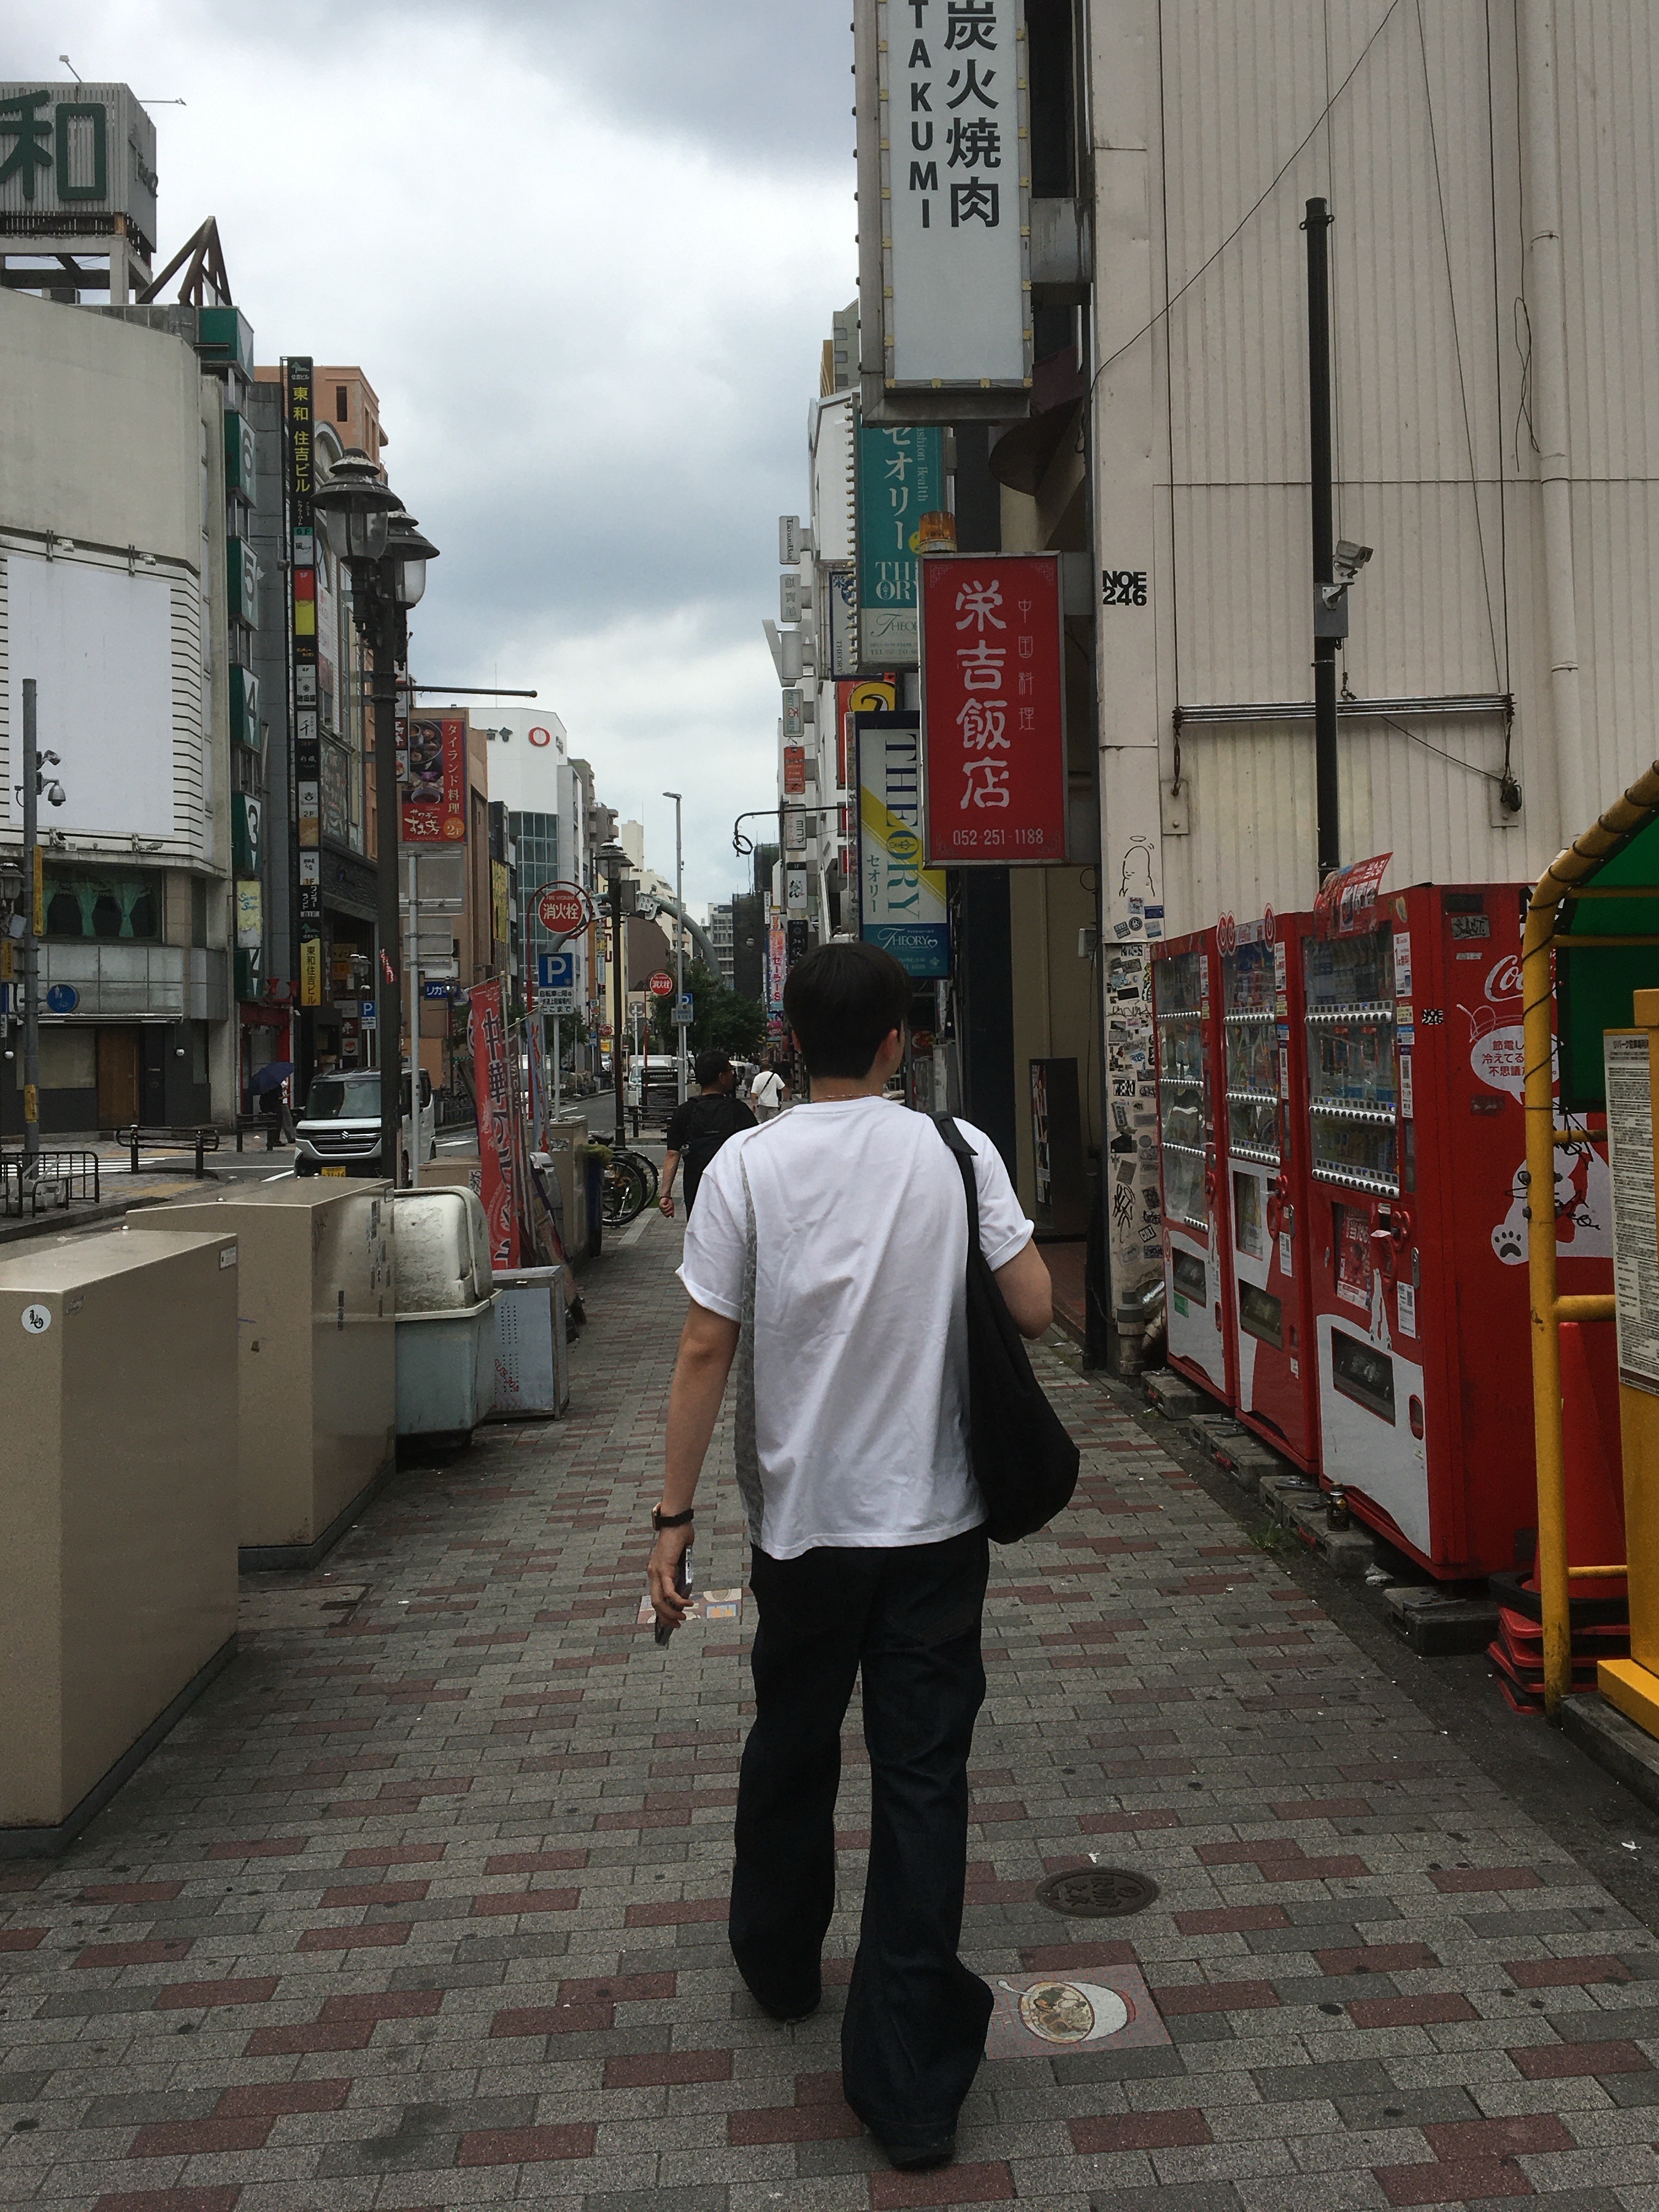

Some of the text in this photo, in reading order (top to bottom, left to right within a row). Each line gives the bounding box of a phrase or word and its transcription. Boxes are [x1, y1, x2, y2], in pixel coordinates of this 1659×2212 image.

[908, 0, 938, 228] TAKUMI
[944, 1, 1001, 228] 炭火焼肉
[917, 466, 928, 502] Health
[876, 580, 918, 600] OR
[1103, 570, 1147, 589] NOE
[1103, 588, 1147, 606] 246
[955, 579, 1011, 809] 栄吉飯店
[448, 725, 461, 815] タイランド料理
[447, 825, 462, 836] 2F
[885, 733, 920, 920] THEORY
[953, 828, 1044, 846] 052-251-1188
[866, 855, 880, 913] セオリー
[543, 903, 579, 920] 消火栓
[547, 957, 567, 984] P
[363, 1003, 373, 1015] P
